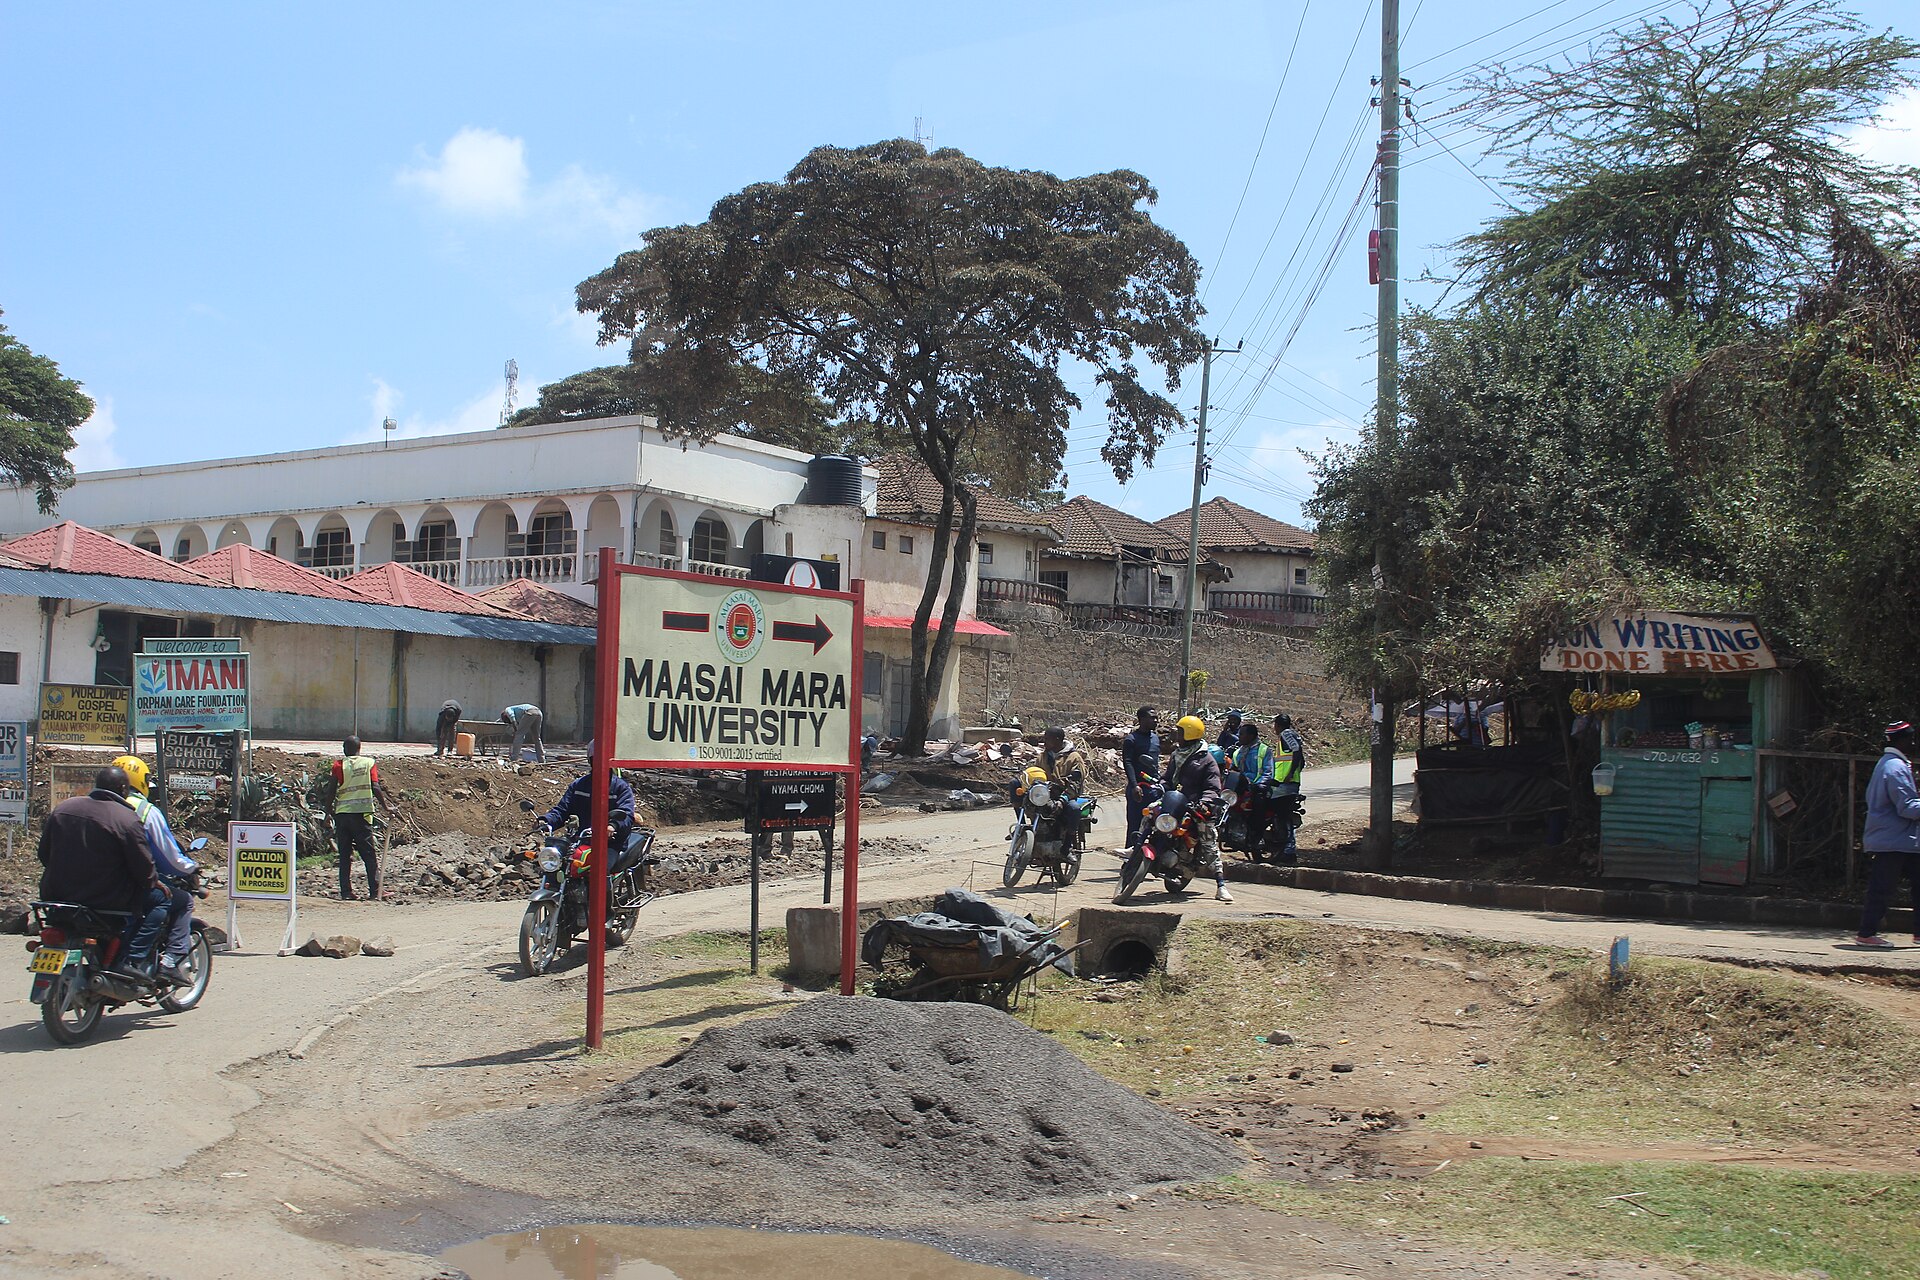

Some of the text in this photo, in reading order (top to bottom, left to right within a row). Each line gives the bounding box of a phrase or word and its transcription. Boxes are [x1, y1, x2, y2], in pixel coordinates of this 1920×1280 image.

[720, 593, 763, 624] MAASAI MARA
[1613, 618, 1761, 652] WRITING
[212, 641, 226, 653] to
[721, 639, 757, 658] UNIVERSITY
[1562, 650, 1759, 671] DONE HERE
[166, 659, 245, 690] IMANI
[623, 657, 846, 710] MAASAI MARA
[71, 687, 127, 700] WORLDWIDE
[77, 700, 117, 712] GOSPEL
[137, 694, 246, 709] ORPHAN CARE FOUNDATION
[41, 710, 127, 723] CHURCH OF KENYA
[68, 722, 100, 733] WORSHIP
[101, 724, 127, 734] CENTRE
[647, 702, 828, 747] UNIVERSITY
[43, 732, 86, 742] Welcome
[167, 734, 217, 748] BILAL
[0, 740, 17, 754] Y
[164, 746, 233, 759] SCHOOLS
[699, 746, 782, 760] ISO 9001:2015 certified
[763, 769, 812, 777] RESTAURANT
[0, 790, 24, 800] LIM
[771, 784, 825, 794] NYAMA CHOMA
[761, 816, 790, 828] Comfort
[797, 815, 832, 828] Tranquility
[240, 851, 284, 861] CAUTION
[242, 866, 283, 879] WORK
[248, 880, 285, 888] PROGRESS
